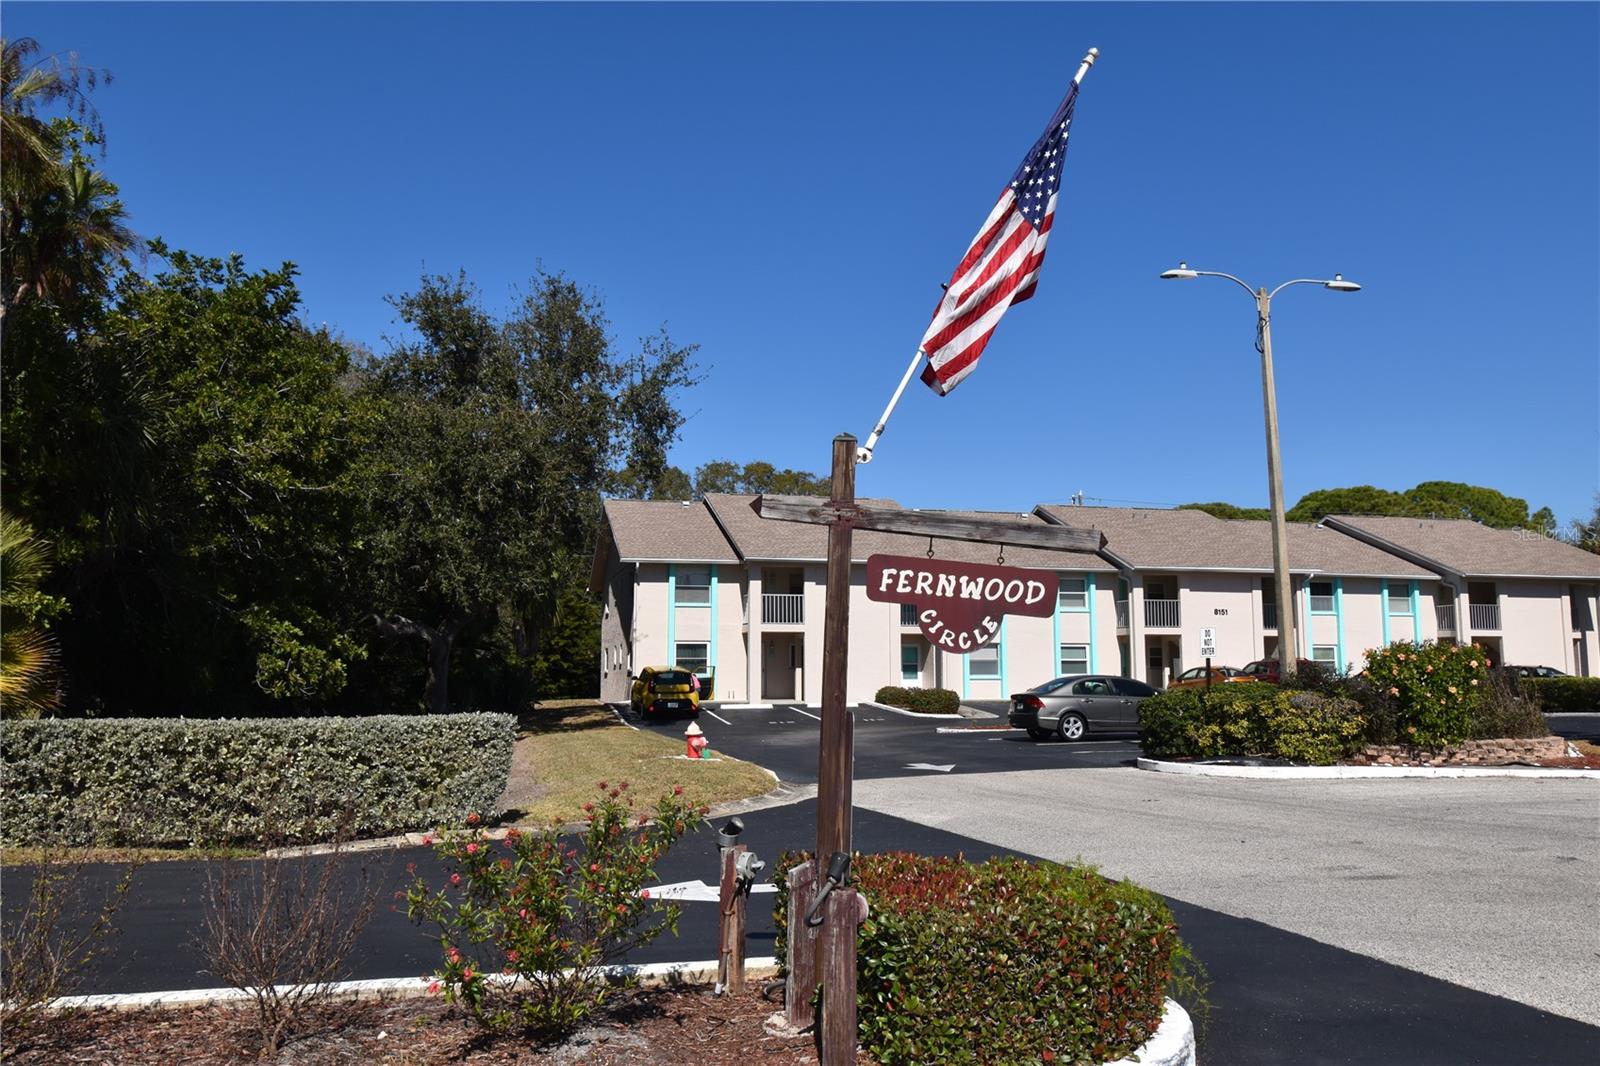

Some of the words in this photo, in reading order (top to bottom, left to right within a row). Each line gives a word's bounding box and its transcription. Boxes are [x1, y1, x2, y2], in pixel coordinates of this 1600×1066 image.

[879, 568, 1046, 605] FERNWOOD
[920, 609, 998, 649] CIRCLE
[1204, 629, 1211, 638] DO
[1203, 638, 1212, 646] NOT
[1201, 647, 1215, 655] ENTER
